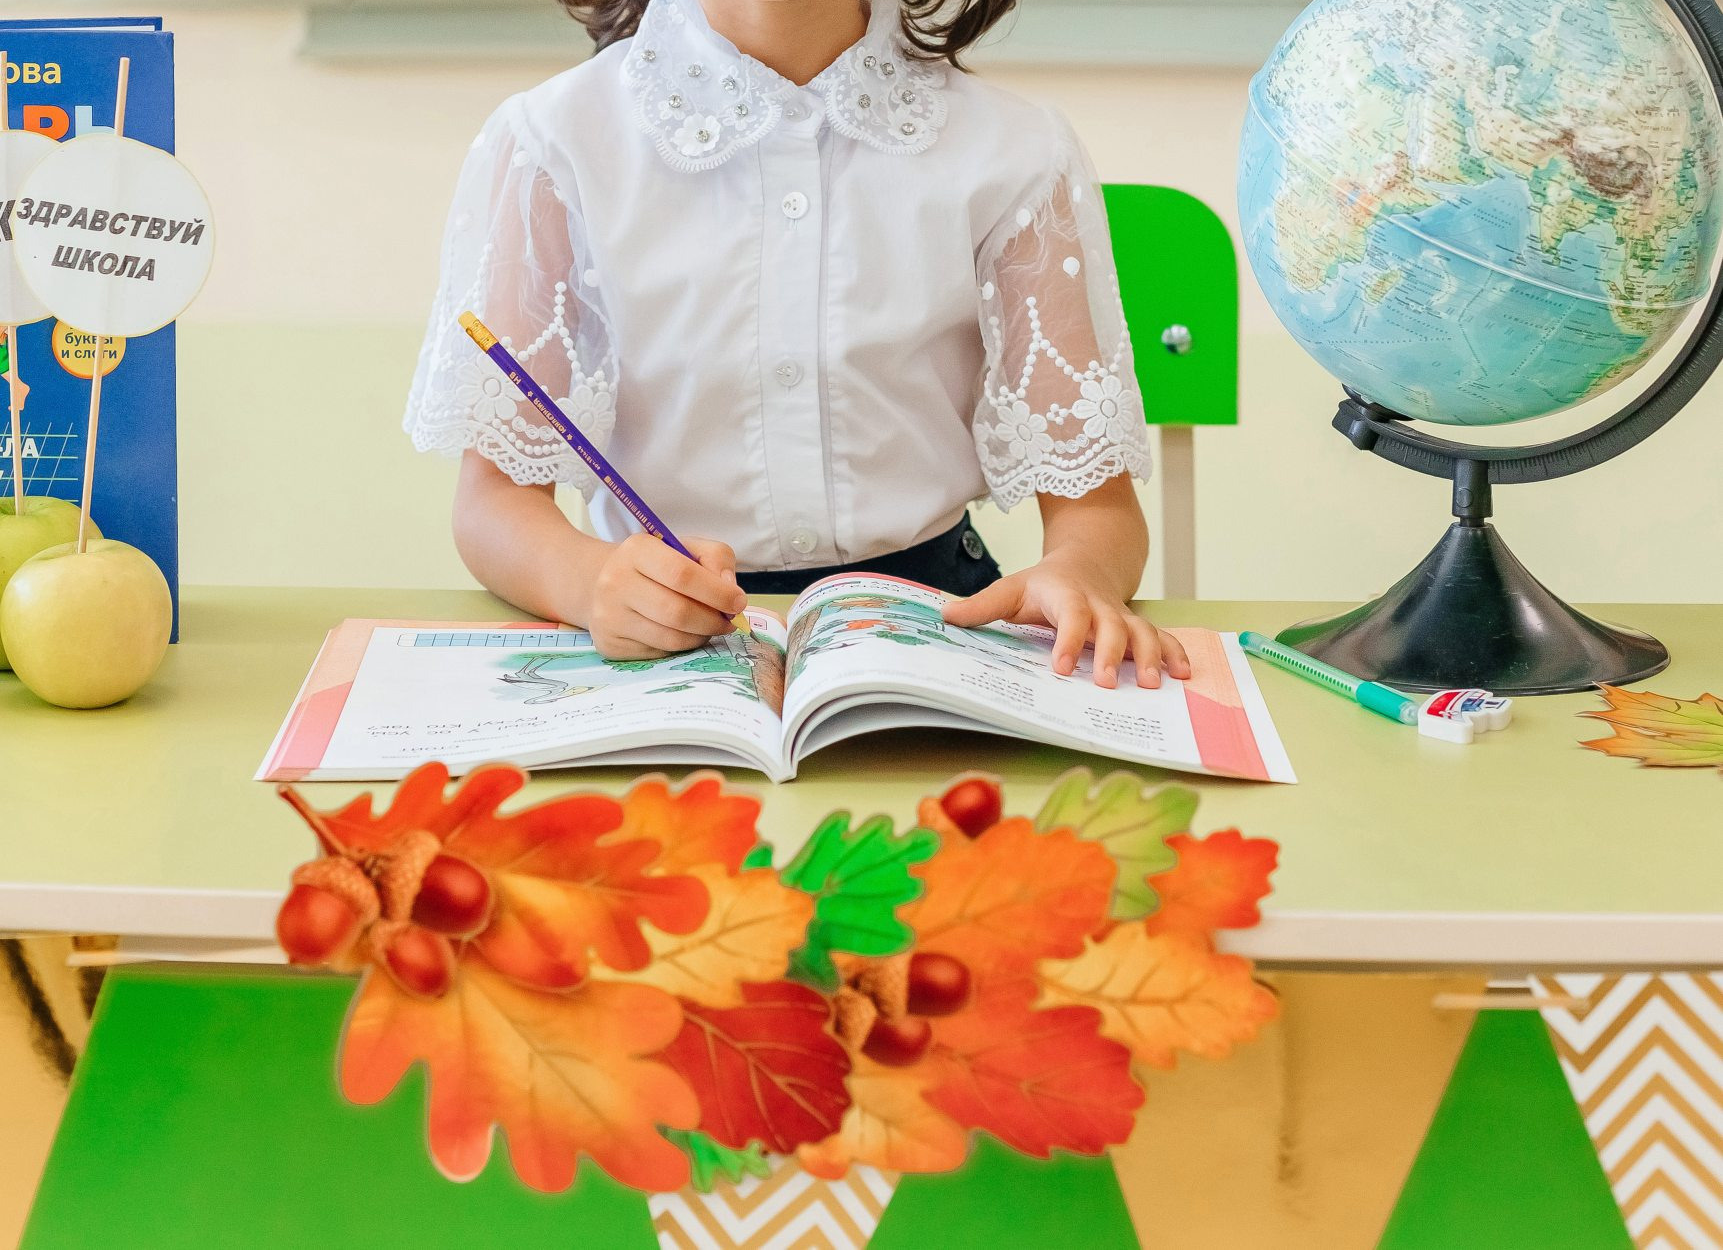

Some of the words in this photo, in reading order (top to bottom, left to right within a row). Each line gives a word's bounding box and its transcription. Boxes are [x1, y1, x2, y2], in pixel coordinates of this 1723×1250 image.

[16, 197, 205, 246] ЗДРАВСТВУЙ
[51, 244, 157, 281] ШКОЛА
[61, 349, 70, 359] и
